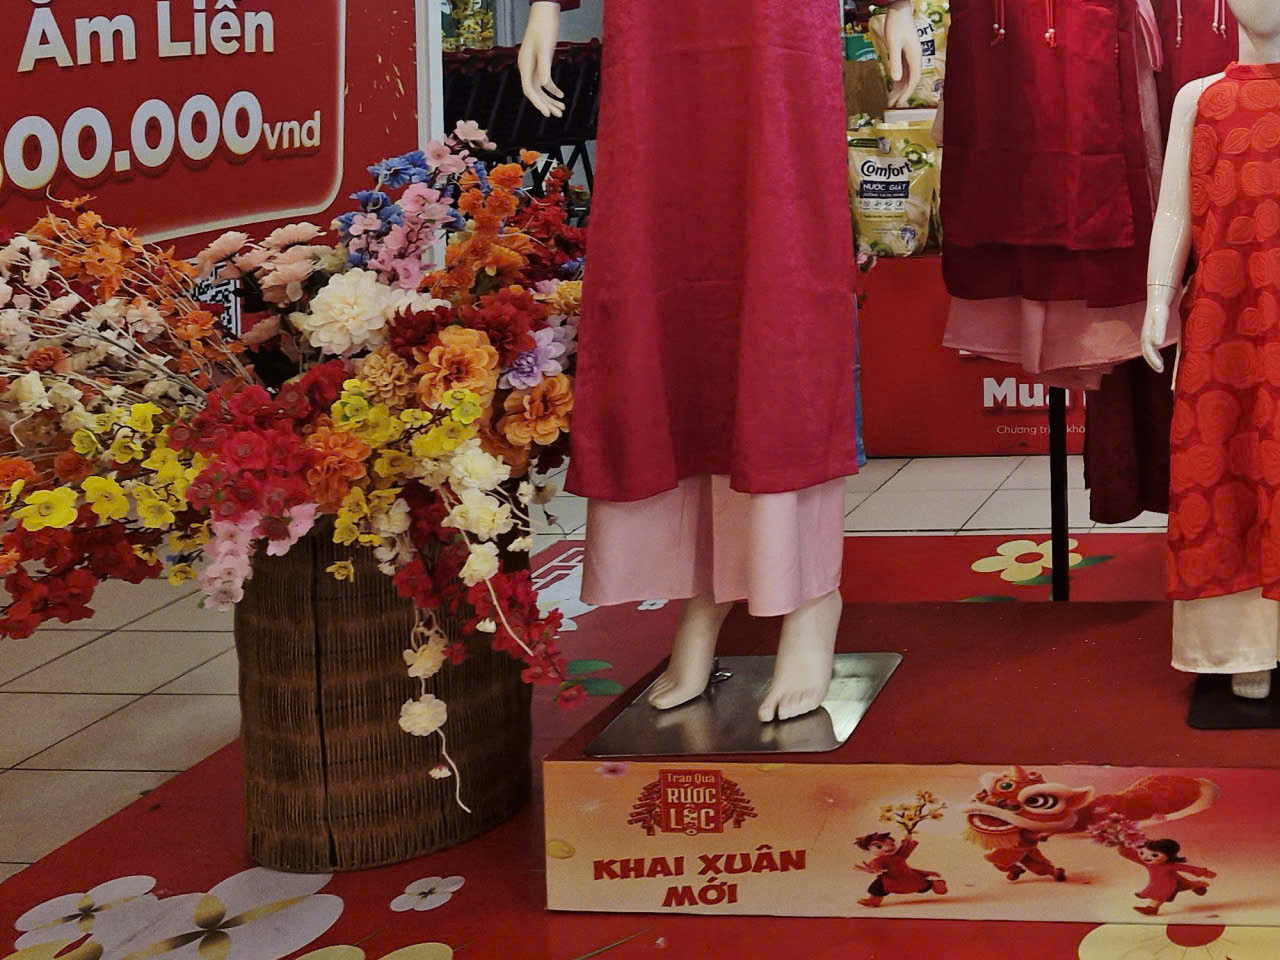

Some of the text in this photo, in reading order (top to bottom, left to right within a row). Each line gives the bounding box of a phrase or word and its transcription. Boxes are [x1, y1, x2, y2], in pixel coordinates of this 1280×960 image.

[860, 159, 913, 180] Comfort
[666, 772, 715, 784] Trao Quà
[665, 783, 717, 804] RƯỚC
[593, 843, 806, 881] KHAI XUÂN
[661, 876, 738, 908] MỚI
